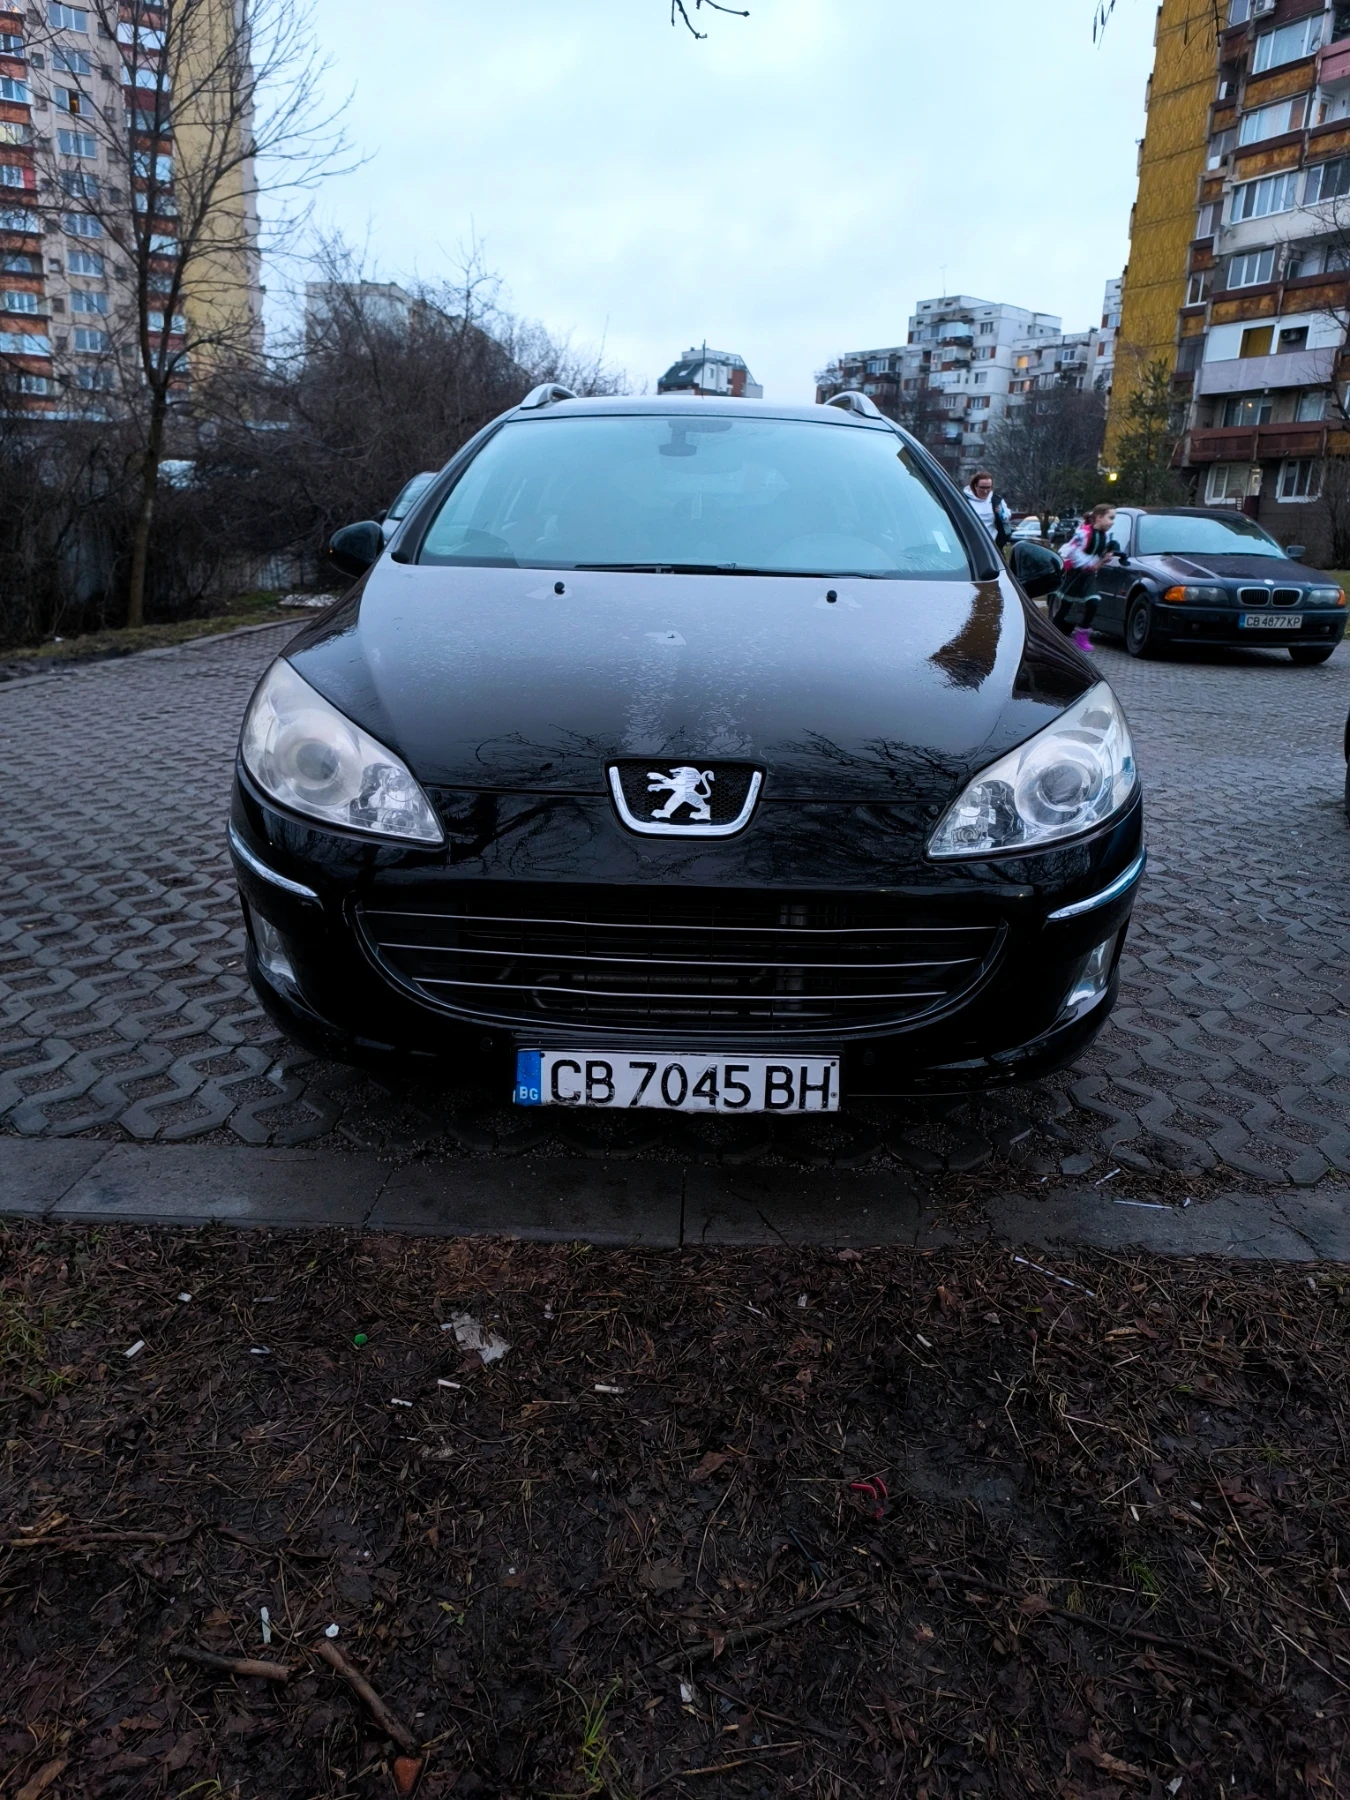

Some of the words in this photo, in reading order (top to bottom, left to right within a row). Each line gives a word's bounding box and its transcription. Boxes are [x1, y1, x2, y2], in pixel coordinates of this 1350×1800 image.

[1246, 616, 1260, 627] CB
[1261, 616, 1286, 627] 4877
[1286, 617, 1300, 627] KP
[550, 1059, 615, 1105] CB
[628, 1061, 752, 1108] 7045
[764, 1064, 831, 1110] BH
[519, 1086, 538, 1101] BG
